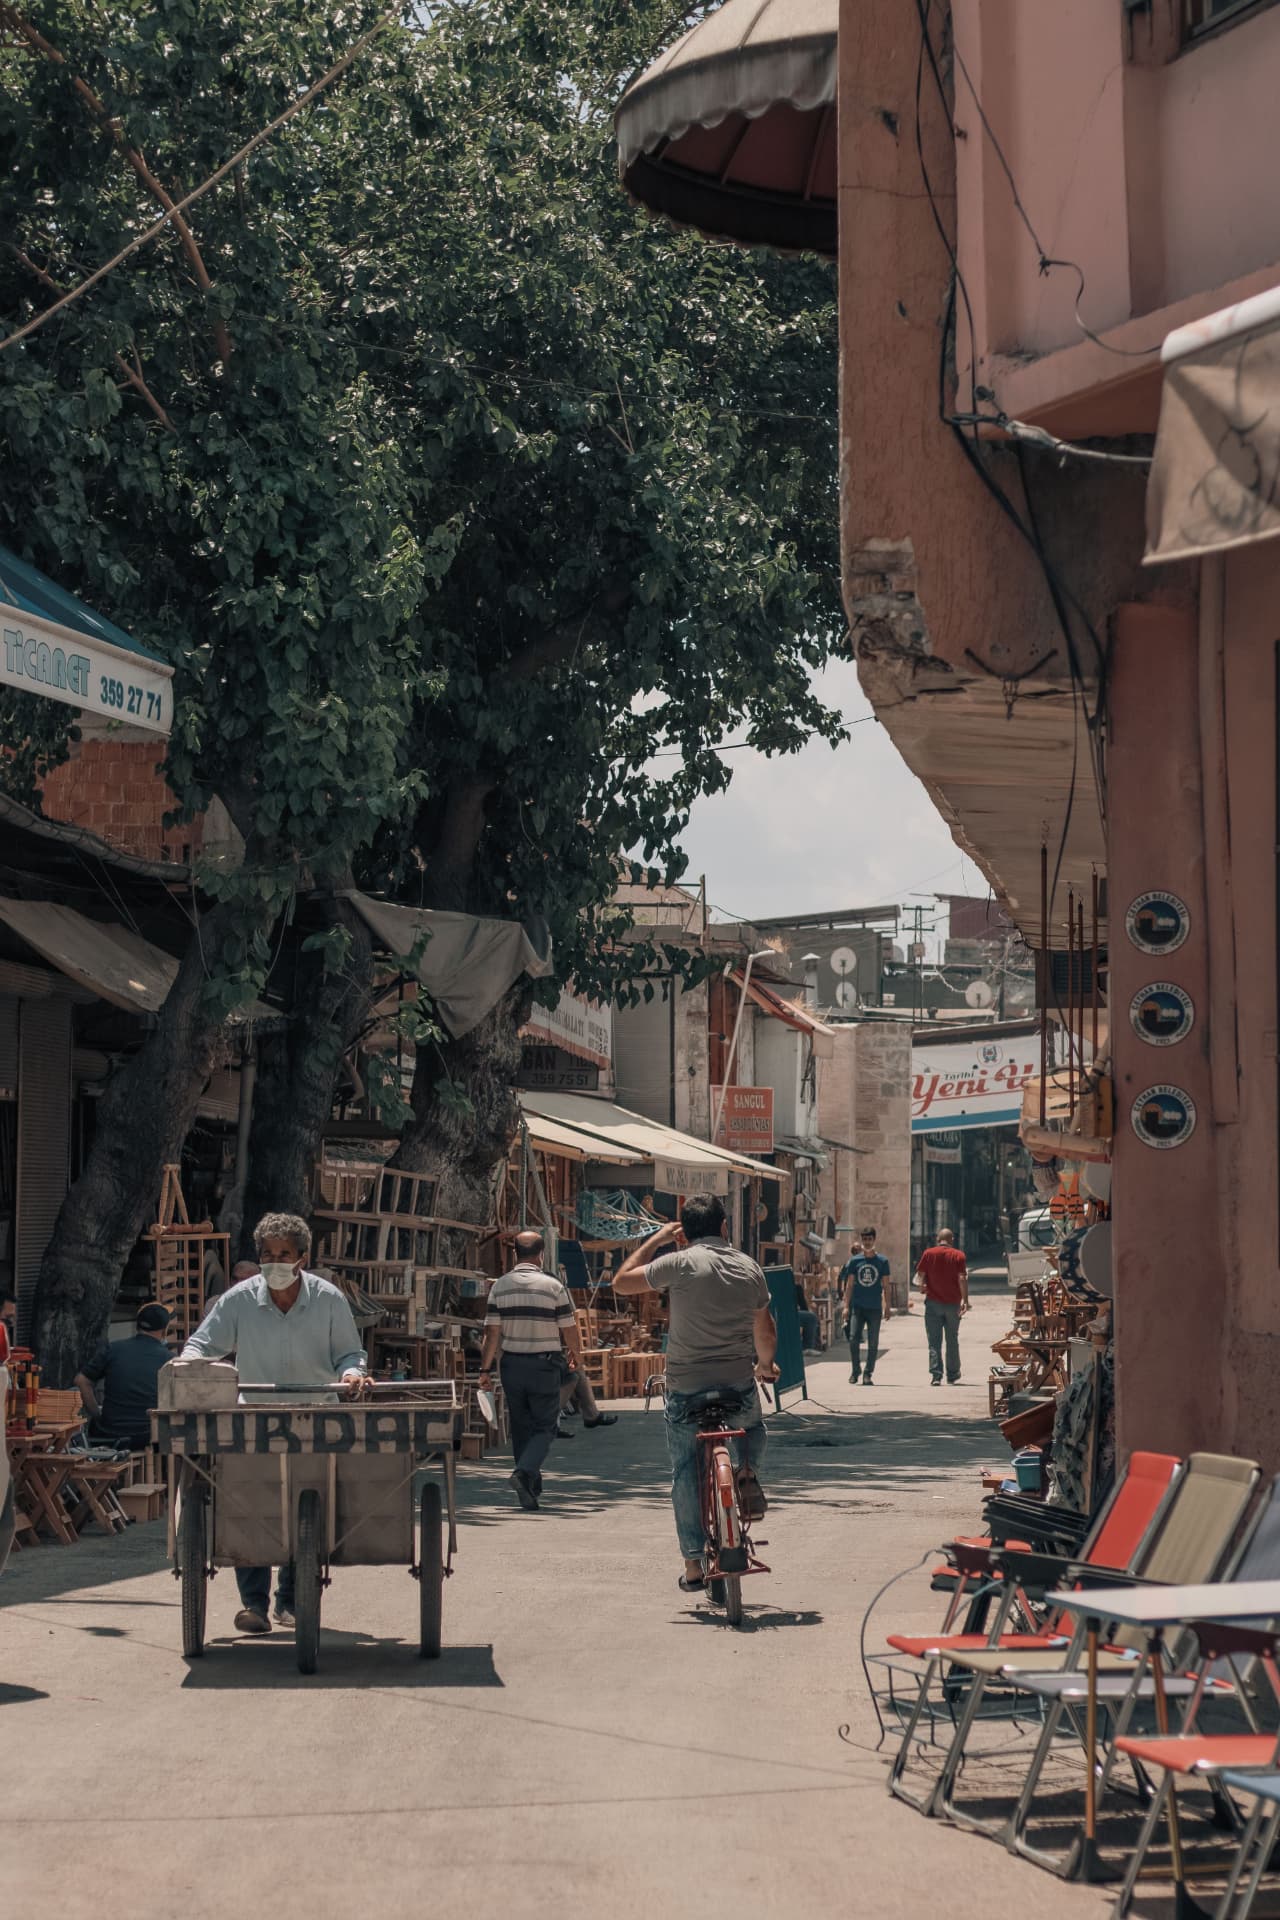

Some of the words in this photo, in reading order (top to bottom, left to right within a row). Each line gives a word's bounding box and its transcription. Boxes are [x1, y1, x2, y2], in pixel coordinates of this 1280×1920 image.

[100, 675, 124, 709] 359
[127, 685, 143, 715] 27
[146, 691, 162, 721] 71
[912, 1068, 990, 1117] Yeni
